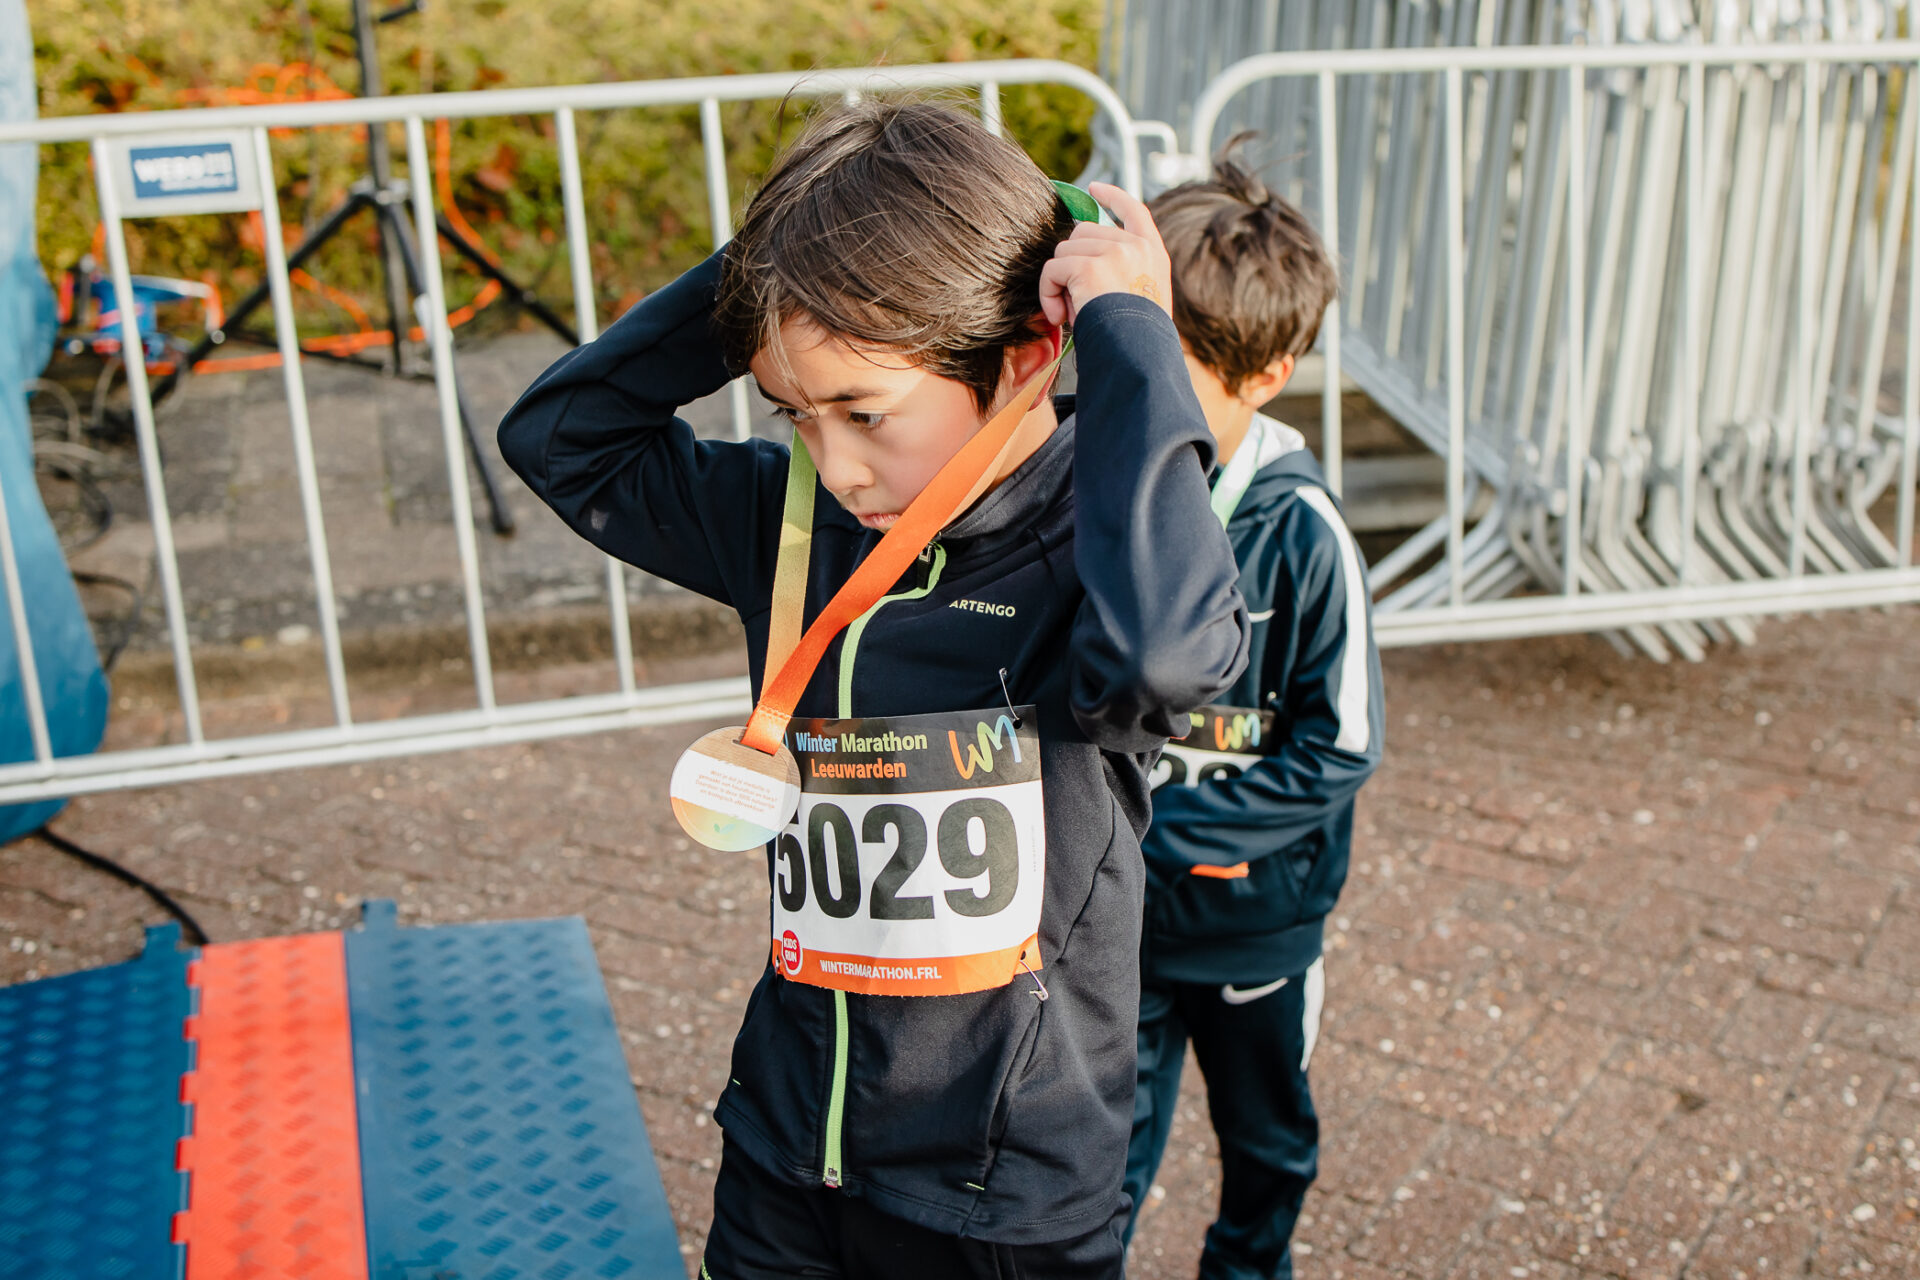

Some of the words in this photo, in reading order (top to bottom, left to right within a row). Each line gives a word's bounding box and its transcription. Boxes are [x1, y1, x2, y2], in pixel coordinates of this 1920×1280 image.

[949, 599, 1016, 617] ARTENGO
[796, 732, 837, 752] Winter
[841, 731, 927, 753] Marathon
[811, 758, 907, 779] Leeuwarden
[777, 797, 1019, 920] 5029
[783, 937, 797, 950] KIDS
[785, 949, 797, 962] RUN
[820, 959, 942, 980] WINTERMARATHON.FRL
